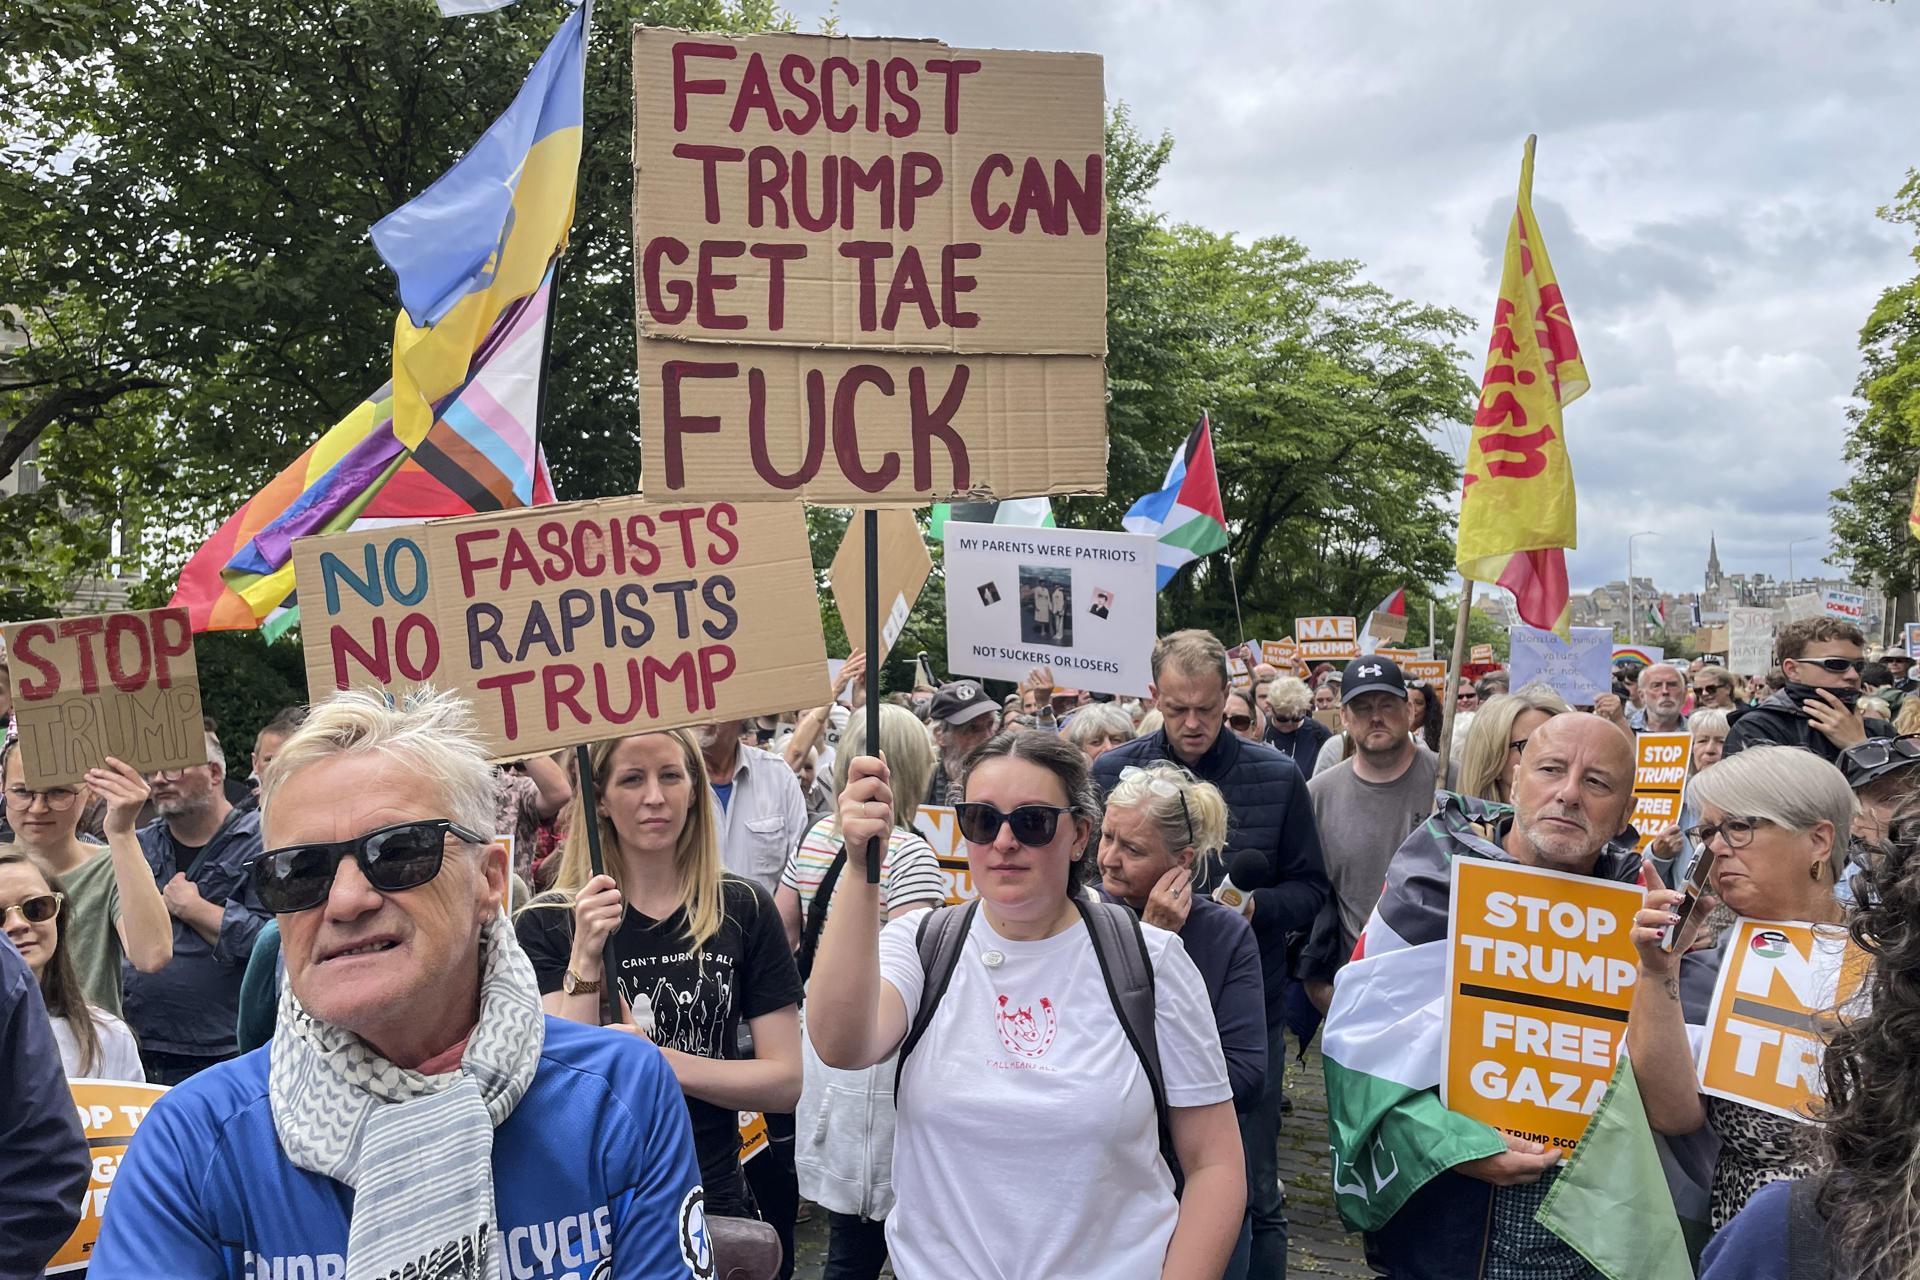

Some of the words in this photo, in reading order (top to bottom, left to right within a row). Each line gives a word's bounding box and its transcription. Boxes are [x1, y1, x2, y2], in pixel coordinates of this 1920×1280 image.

[672, 41, 982, 137] FASCIST
[672, 143, 943, 232] TRUMP
[970, 152, 1102, 236] CAN
[643, 236, 807, 330] GET
[837, 240, 982, 331] TAE
[662, 360, 970, 492] FUCK
[320, 536, 429, 616] NO
[455, 502, 739, 598] FASCISTS
[960, 538, 978, 550] MY
[982, 539, 1034, 554] PARENTS
[1037, 545, 1071, 557] WERE
[1075, 547, 1136, 562] PATRIOTS
[12, 608, 193, 701] STOP
[330, 611, 441, 692] NO
[466, 574, 739, 669] RAPISTS
[1267, 645, 1292, 655] STOP
[1300, 641, 1354, 654] TRUMP
[1301, 619, 1353, 639] NAE
[973, 645, 997, 658] NOT
[1000, 648, 1050, 664] SUCKERS
[1054, 656, 1070, 667] OR
[1074, 658, 1119, 673] LOSERS
[1264, 655, 1294, 665] TRUM
[477, 644, 736, 741] TRUMP
[16, 684, 204, 777] TRUMP
[1644, 746, 1682, 762] STOP
[1638, 767, 1684, 784] TRUMP
[1636, 797, 1673, 815] FREE
[1483, 891, 1617, 943] STOP
[622, 956, 656, 969] CAN'T
[661, 952, 694, 964] BURN
[716, 953, 734, 967] ALL
[1460, 934, 1637, 995] TRUMP
[1482, 1011, 1611, 1068] FREE
[1552, 1137, 1579, 1149] SCO
[498, 1205, 612, 1280] ICYCLE
